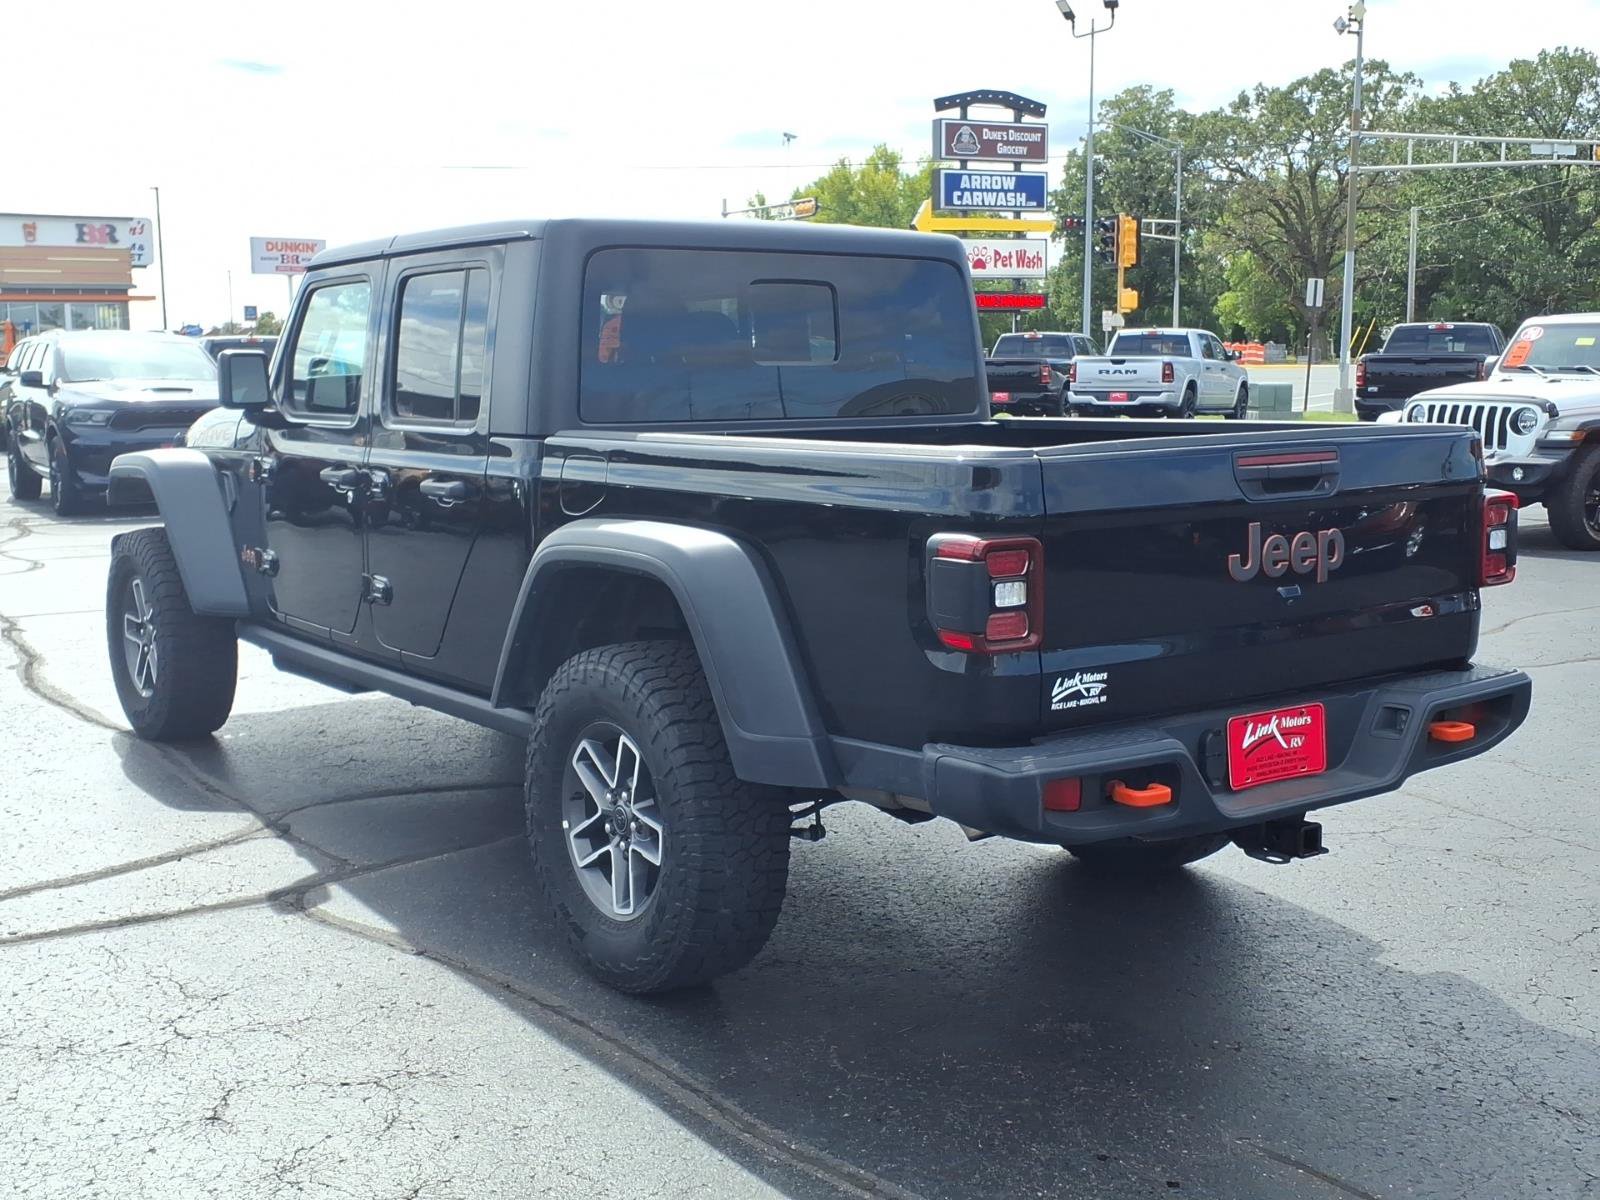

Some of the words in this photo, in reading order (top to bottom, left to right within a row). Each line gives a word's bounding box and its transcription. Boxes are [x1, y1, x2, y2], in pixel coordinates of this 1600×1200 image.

[982, 128, 1007, 140] DUKE'S
[1008, 129, 1042, 143] DISCOUNT
[996, 143, 1028, 156] GROCERY
[960, 175, 1016, 190] ARROW
[993, 249, 1013, 269] Pet
[1015, 249, 1043, 270] Wash
[1228, 522, 1345, 583] Jeep
[1051, 672, 1089, 697] Link
[1082, 672, 1108, 682] Motors
[1089, 687, 1102, 696] RV
[1242, 715, 1288, 750] Link
[1281, 716, 1312, 728] Motors
[1290, 735, 1305, 748] RV
